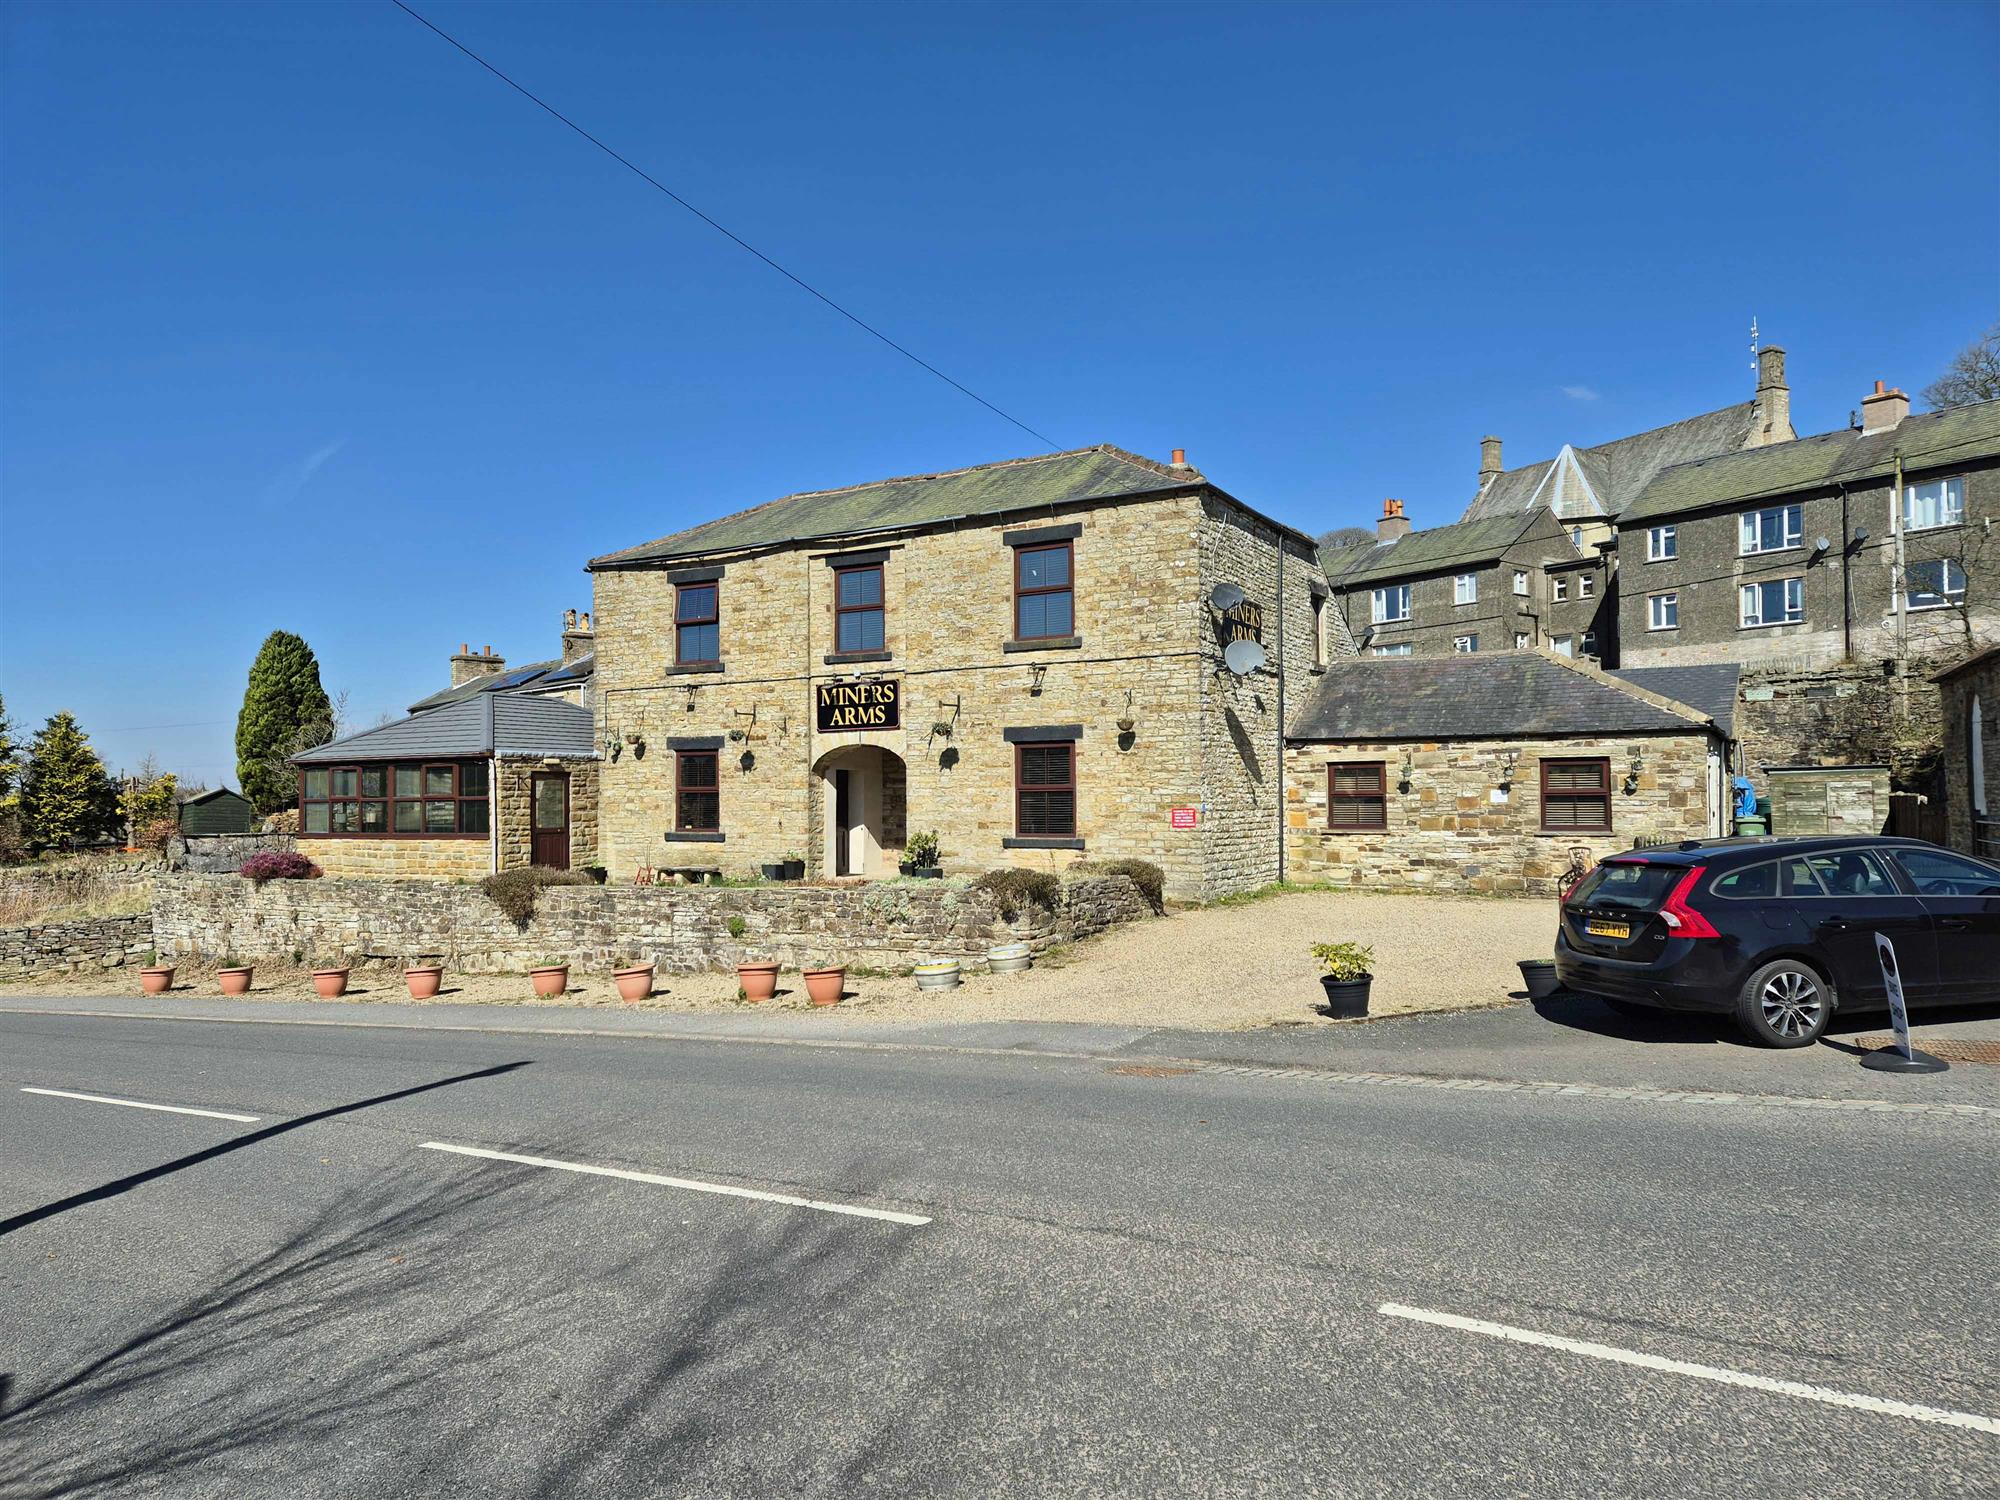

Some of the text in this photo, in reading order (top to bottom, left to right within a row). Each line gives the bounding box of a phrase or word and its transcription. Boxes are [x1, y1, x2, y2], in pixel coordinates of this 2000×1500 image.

[1230, 624, 1257, 642] ARMS
[820, 684, 895, 706] MINERS
[829, 705, 886, 726] ARMS
